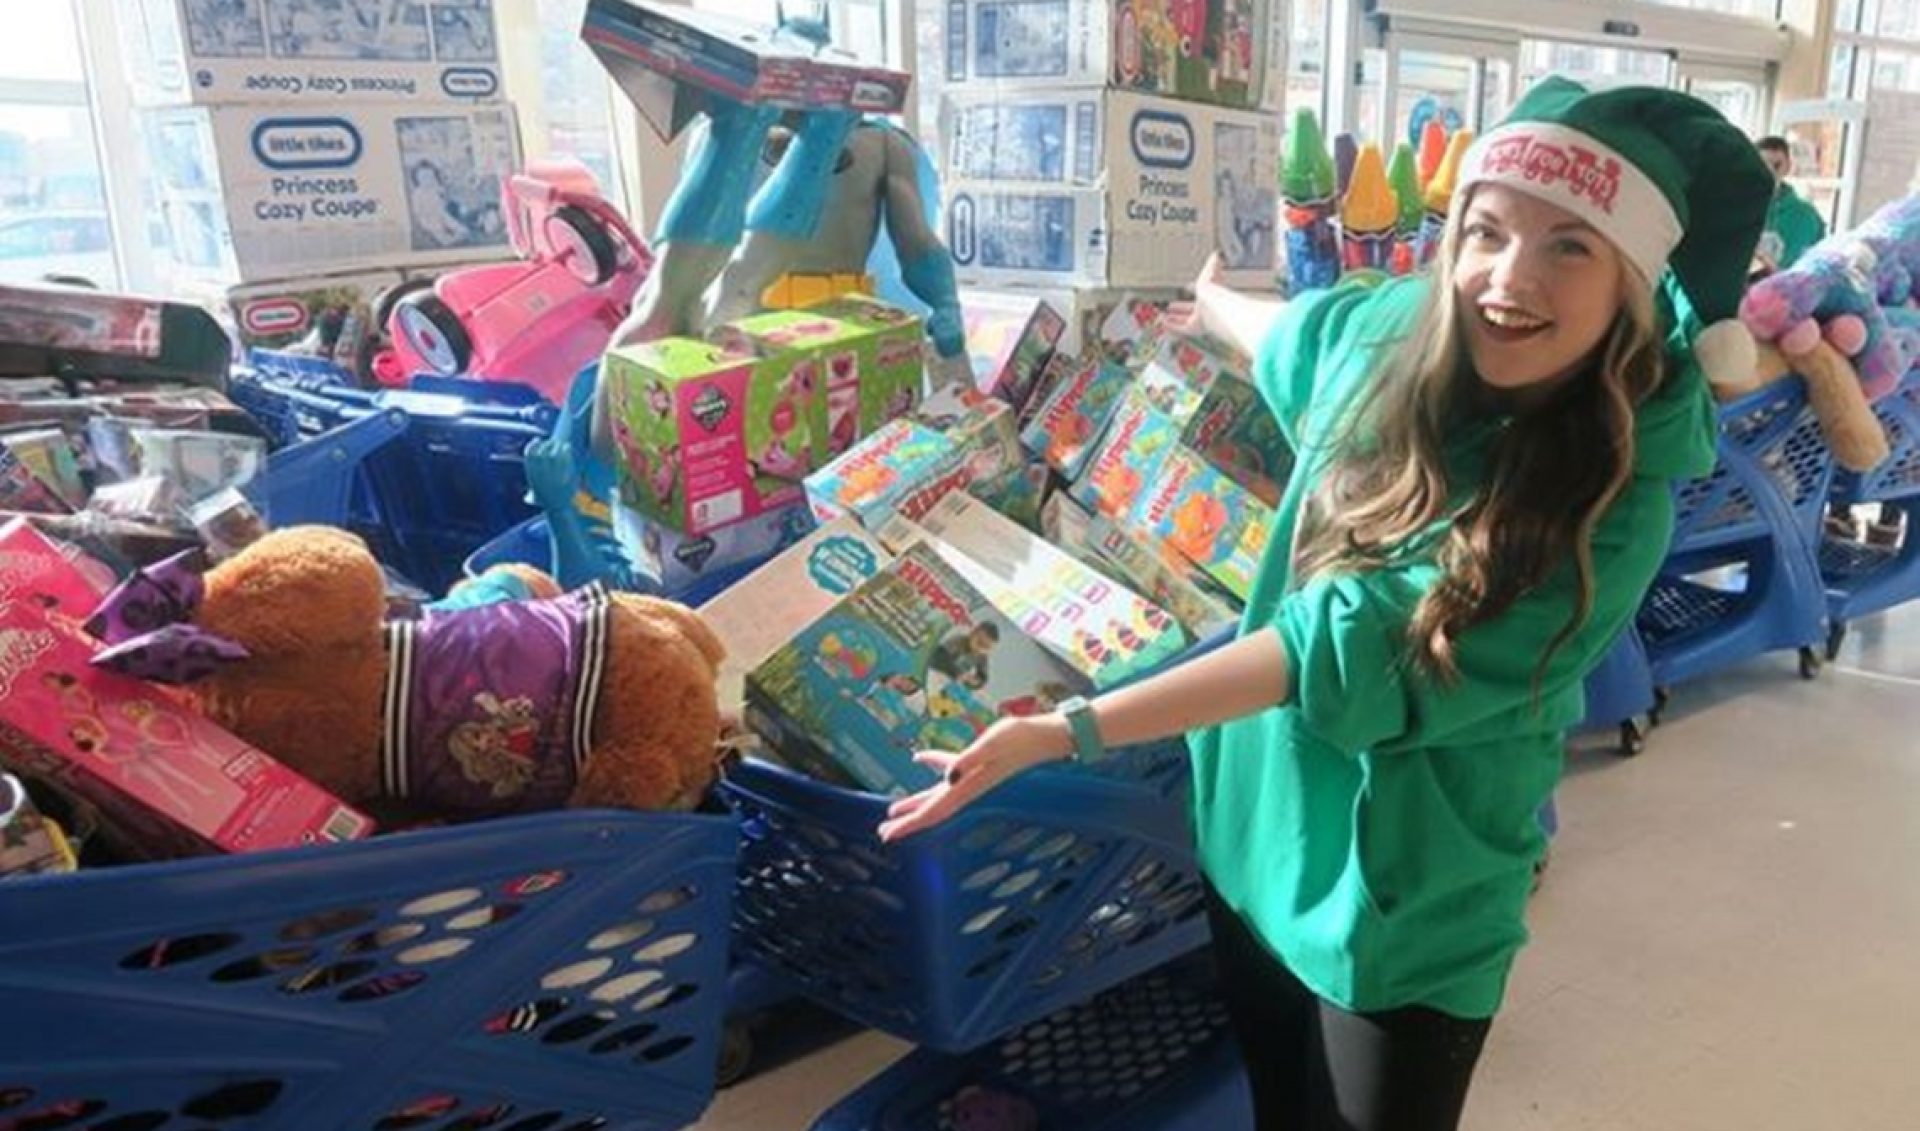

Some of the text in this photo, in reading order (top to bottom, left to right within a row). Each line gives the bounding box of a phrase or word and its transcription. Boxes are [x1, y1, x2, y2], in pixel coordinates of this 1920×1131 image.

[245, 74, 416, 95] Princess Cozy Coupe
[271, 176, 359, 195] Princess
[1139, 174, 1188, 198] Princess
[254, 197, 377, 221] Cozy Coupe
[1126, 199, 1198, 225] Cozy Coupe
